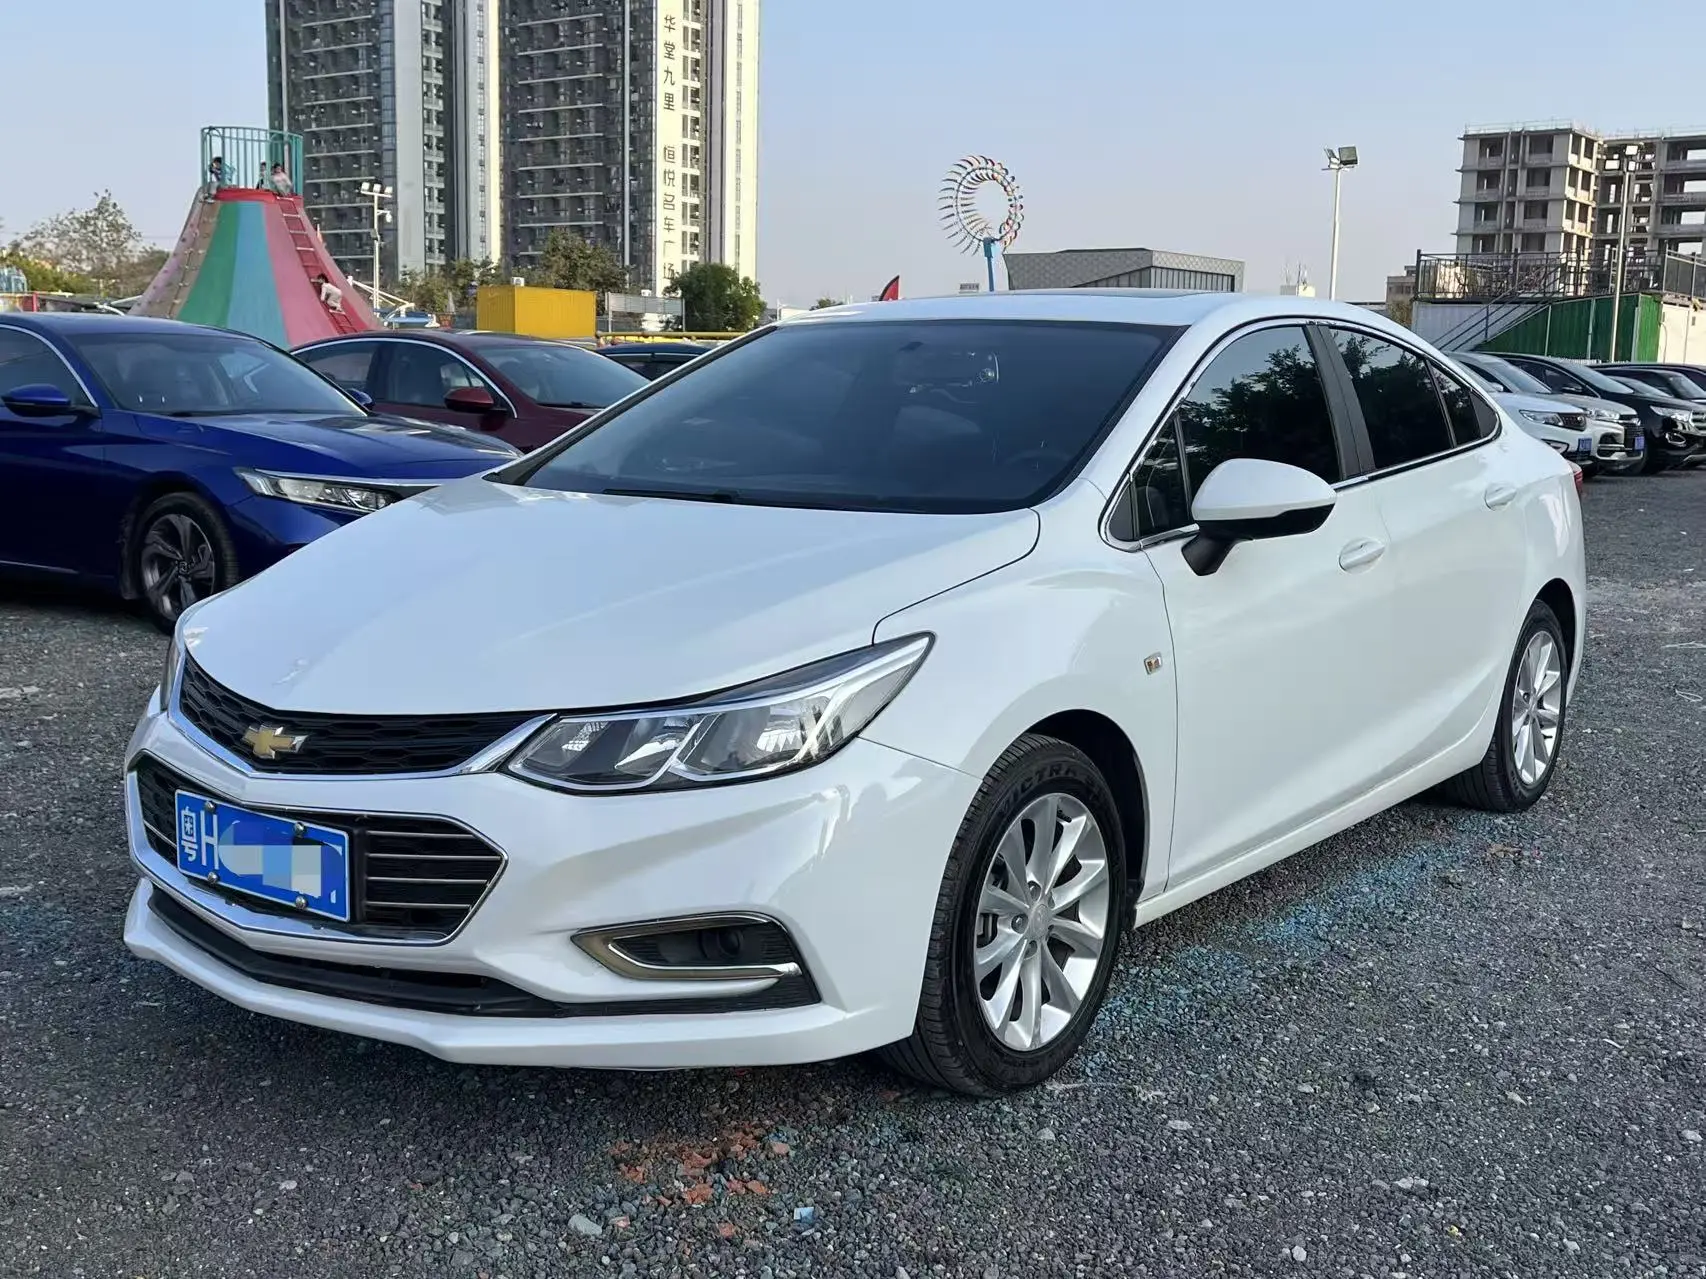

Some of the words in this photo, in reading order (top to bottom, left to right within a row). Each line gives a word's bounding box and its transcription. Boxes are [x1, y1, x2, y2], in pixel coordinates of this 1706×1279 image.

[663, 14, 676, 111] 华堂九里
[662, 144, 676, 281] 恒悦名车广场
